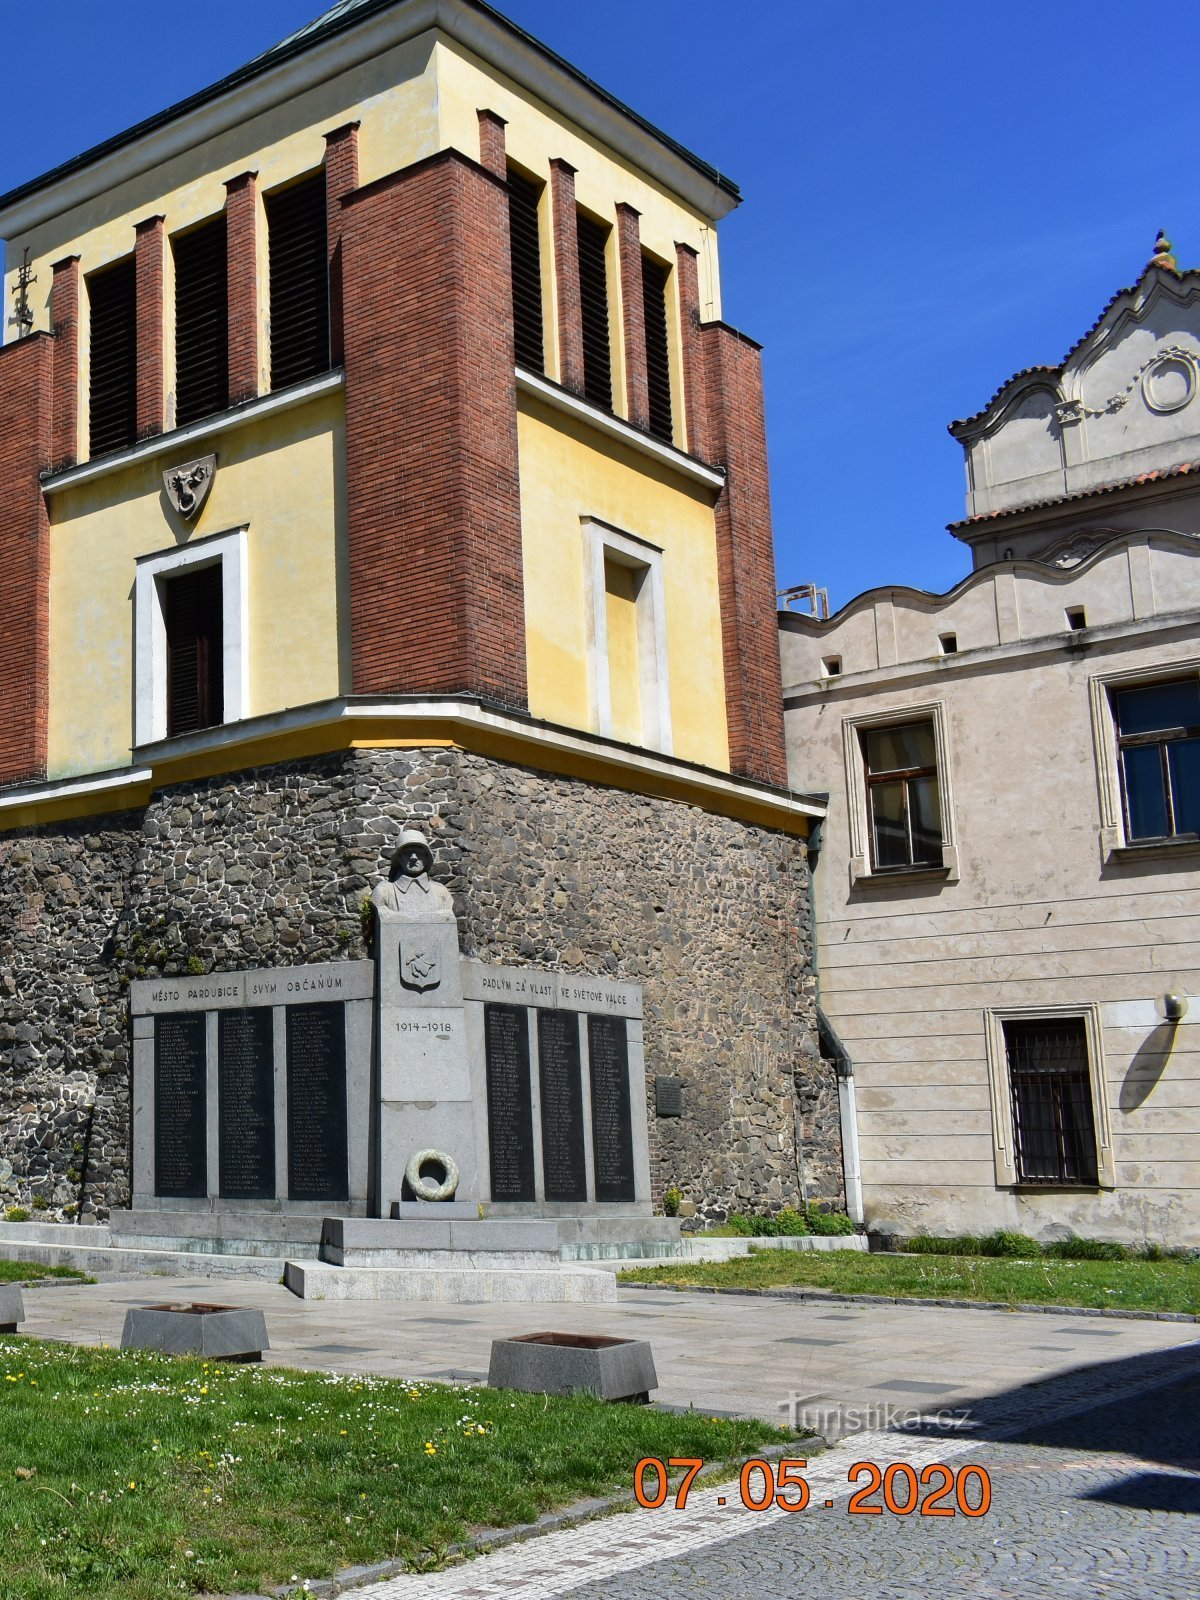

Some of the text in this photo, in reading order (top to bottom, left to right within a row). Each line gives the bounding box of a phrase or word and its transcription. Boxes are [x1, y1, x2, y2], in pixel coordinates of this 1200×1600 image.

[152, 990, 180, 1002] MĚSTO
[188, 986, 239, 999] PARDUBICE
[252, 981, 277, 995] SVÝM
[482, 978, 512, 991] PADLÝM
[530, 983, 552, 996] VLAST
[561, 987, 570, 998] VE
[395, 1022, 454, 1032] 1914-1918.
